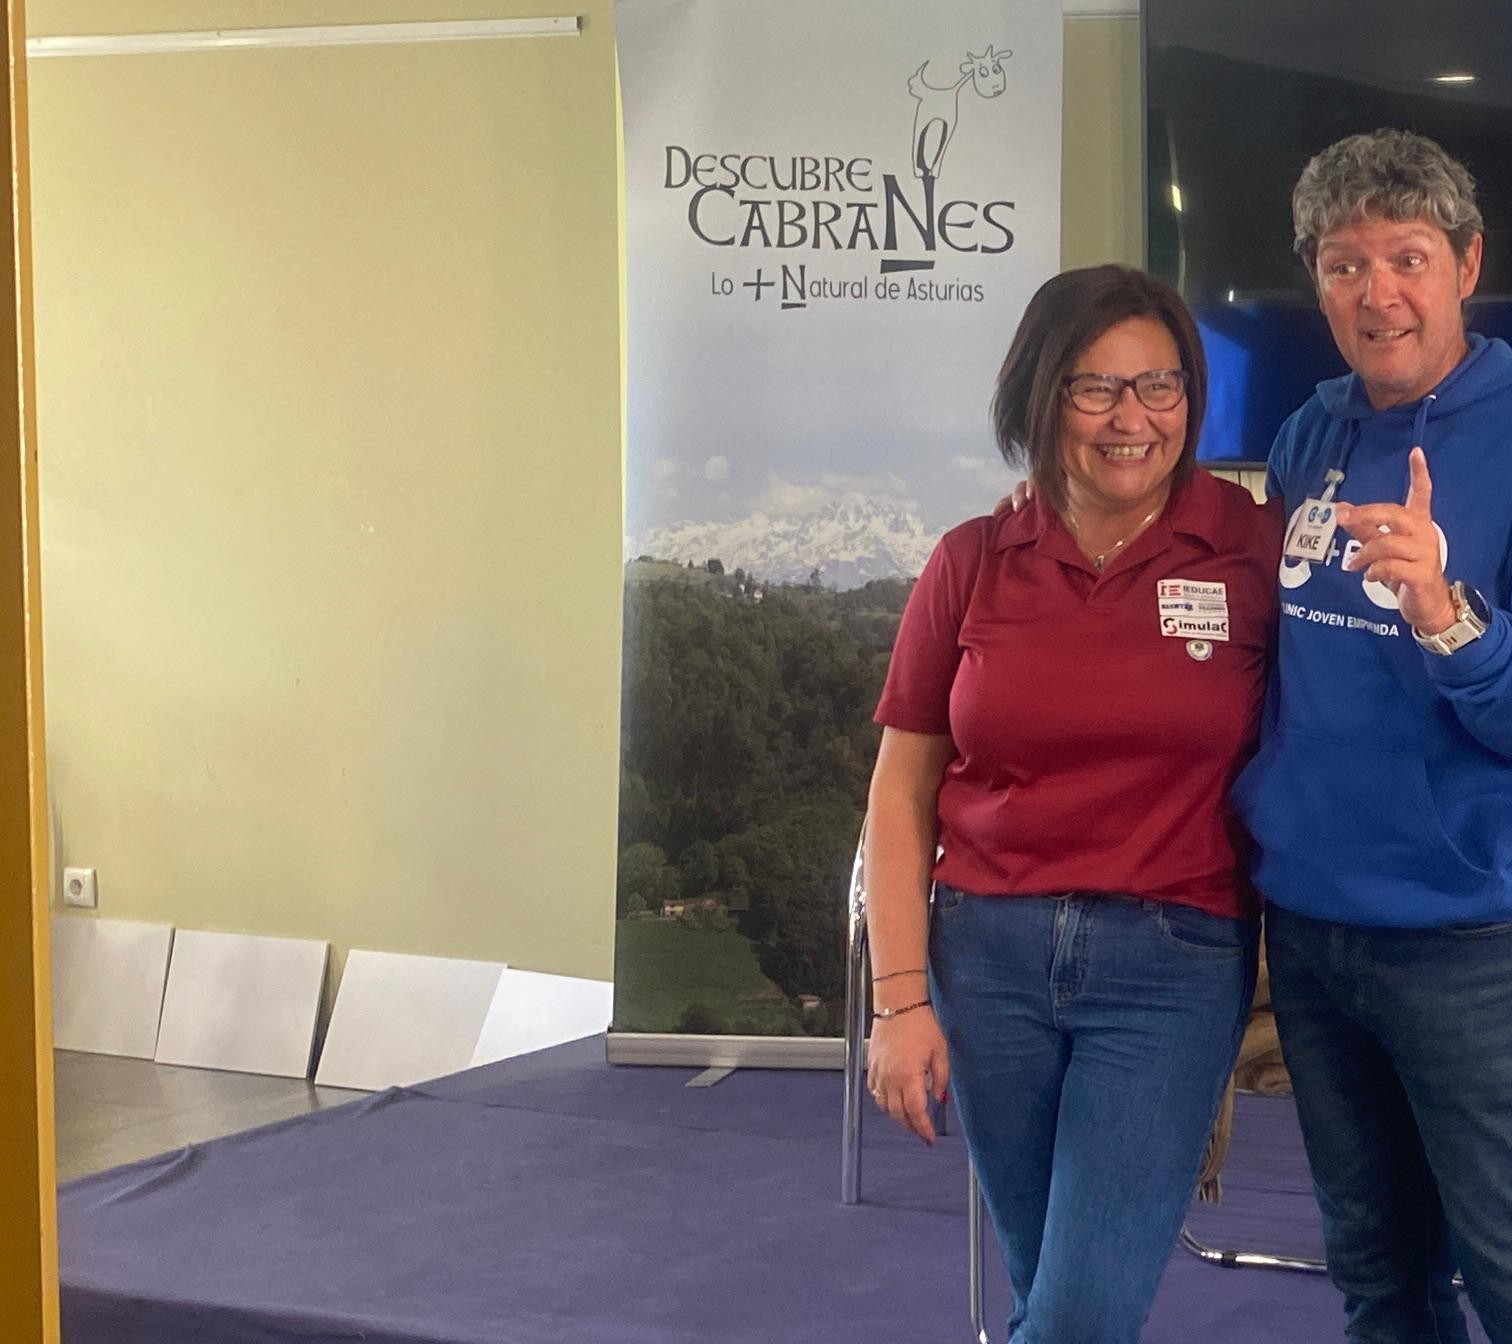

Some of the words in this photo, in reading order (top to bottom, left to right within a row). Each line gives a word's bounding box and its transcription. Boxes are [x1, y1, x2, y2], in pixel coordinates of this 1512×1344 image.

[664, 145, 873, 192] DESCUBRE
[711, 271, 734, 296] Lo
[874, 275, 901, 301] de
[907, 277, 985, 302] Asturias
[1296, 534, 1322, 551] KIKE
[1306, 609, 1345, 627] JOVEN
